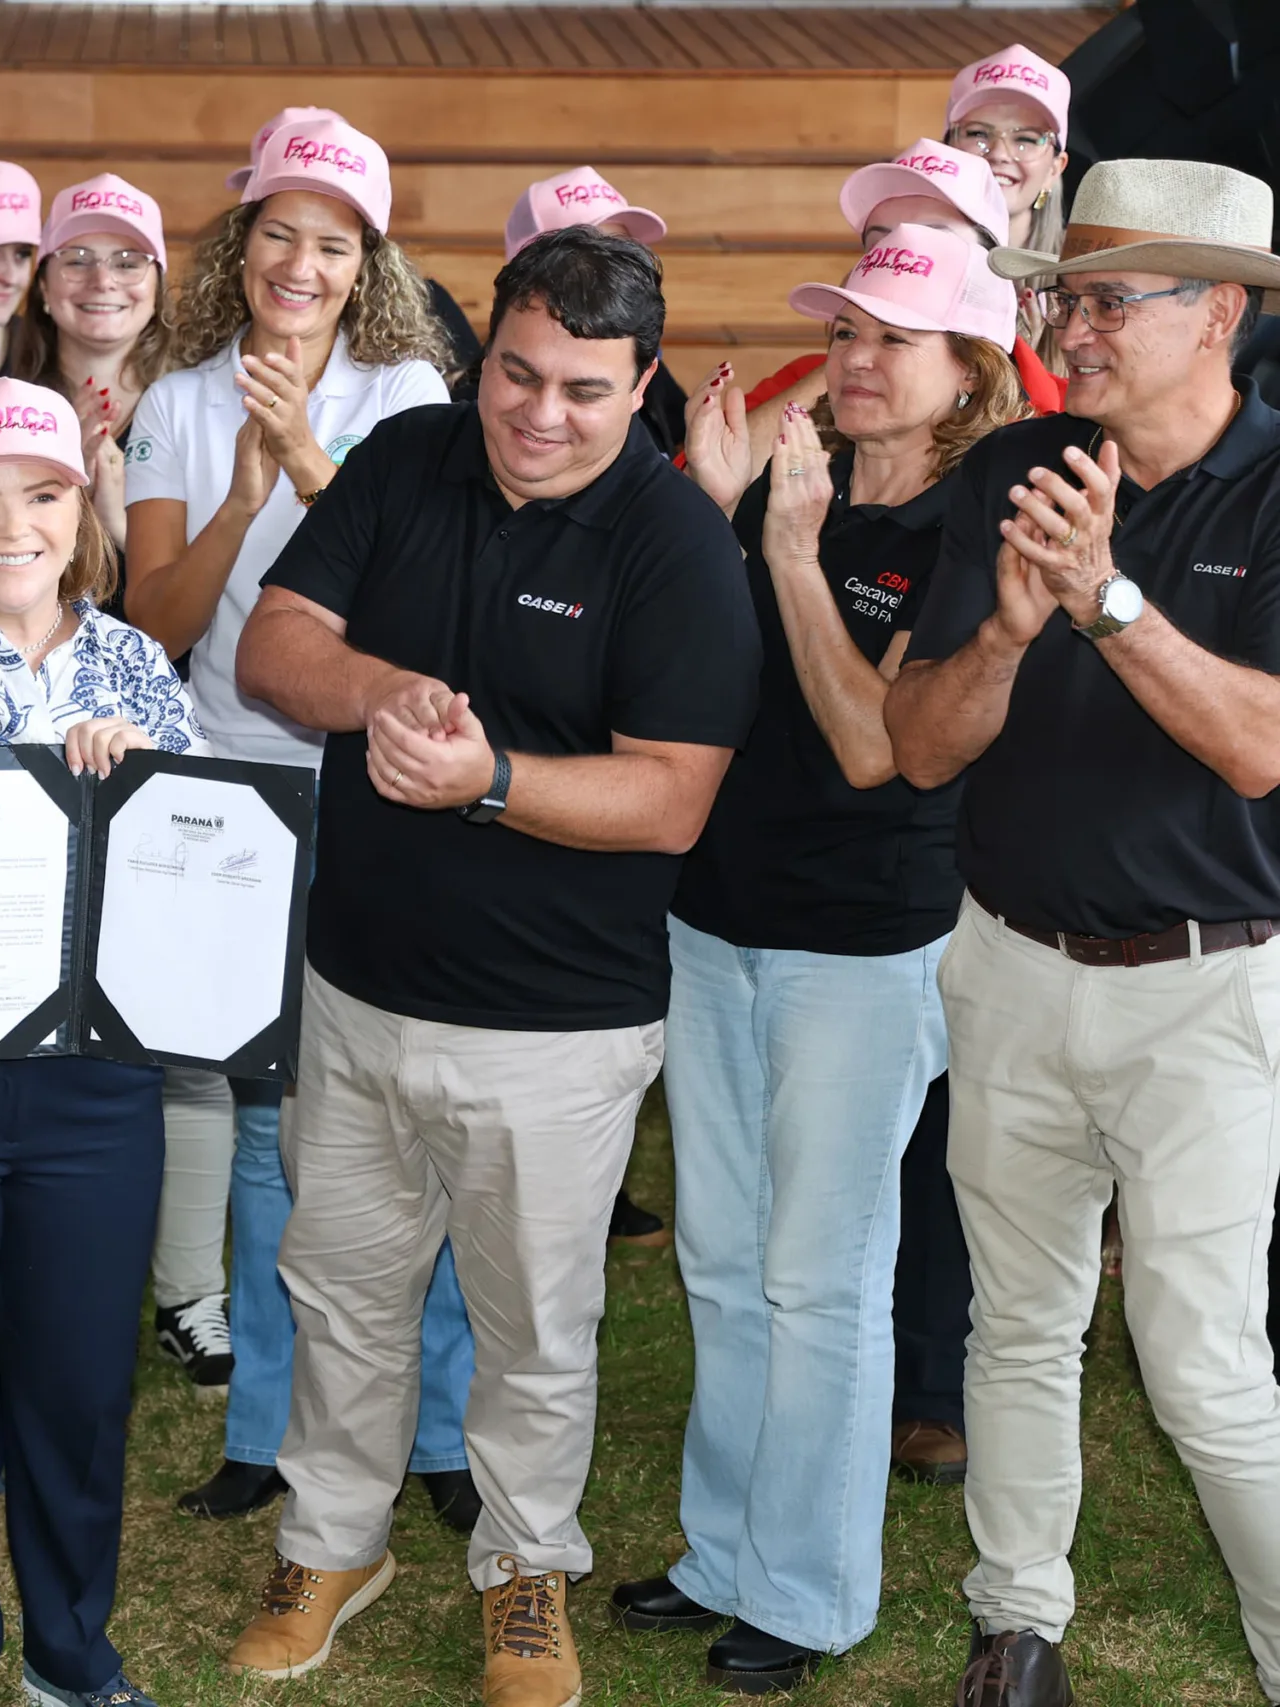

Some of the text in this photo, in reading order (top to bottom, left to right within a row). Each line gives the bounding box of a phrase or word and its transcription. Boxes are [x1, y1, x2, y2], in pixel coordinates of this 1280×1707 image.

[283, 136, 367, 176] Força
[1193, 563, 1233, 576] CASE
[844, 576, 903, 609] Cascavel
[517, 594, 568, 614] CASE
[852, 599, 878, 616] 93,9
[171, 814, 213, 828] PARANÁ
